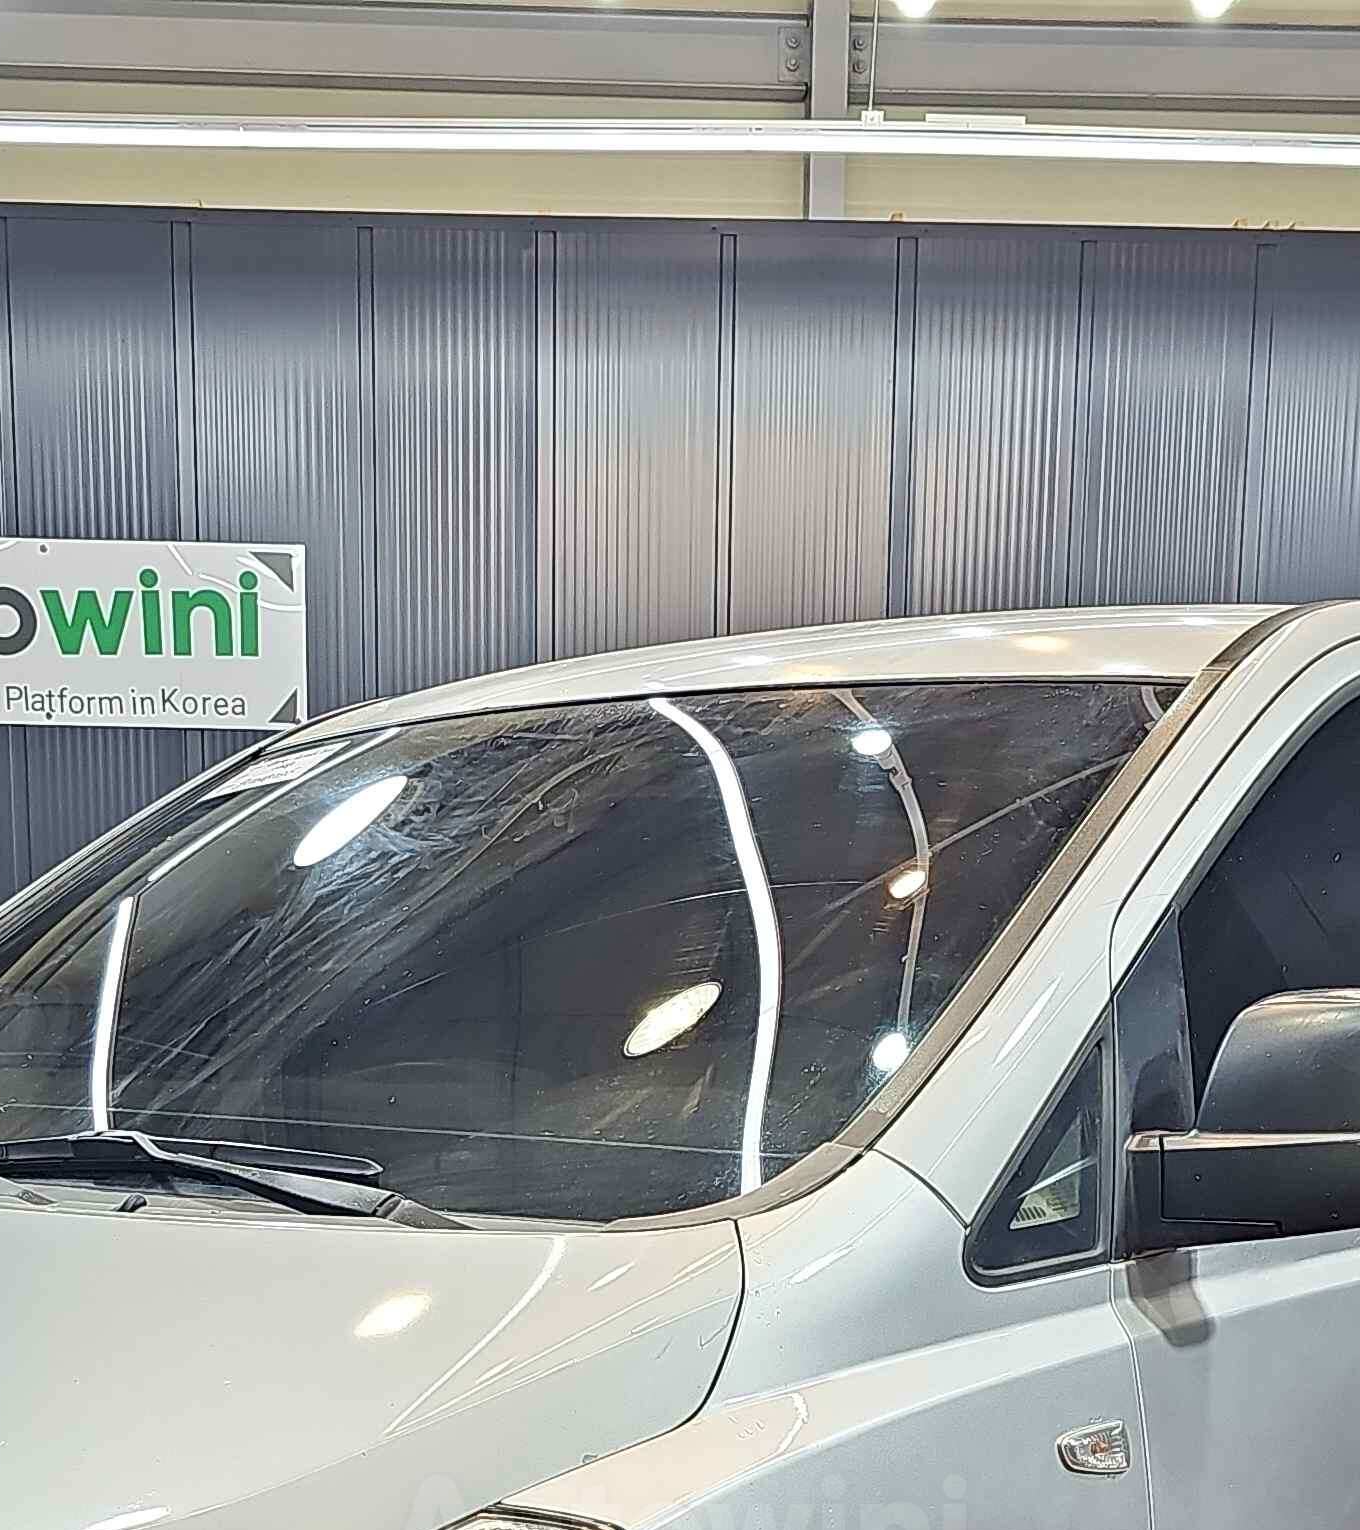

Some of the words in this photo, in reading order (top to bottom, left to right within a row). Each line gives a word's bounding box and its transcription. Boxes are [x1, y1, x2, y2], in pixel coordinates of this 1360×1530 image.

[5, 685, 124, 715] Platform
[130, 688, 156, 715] in
[160, 687, 247, 717] Korea
